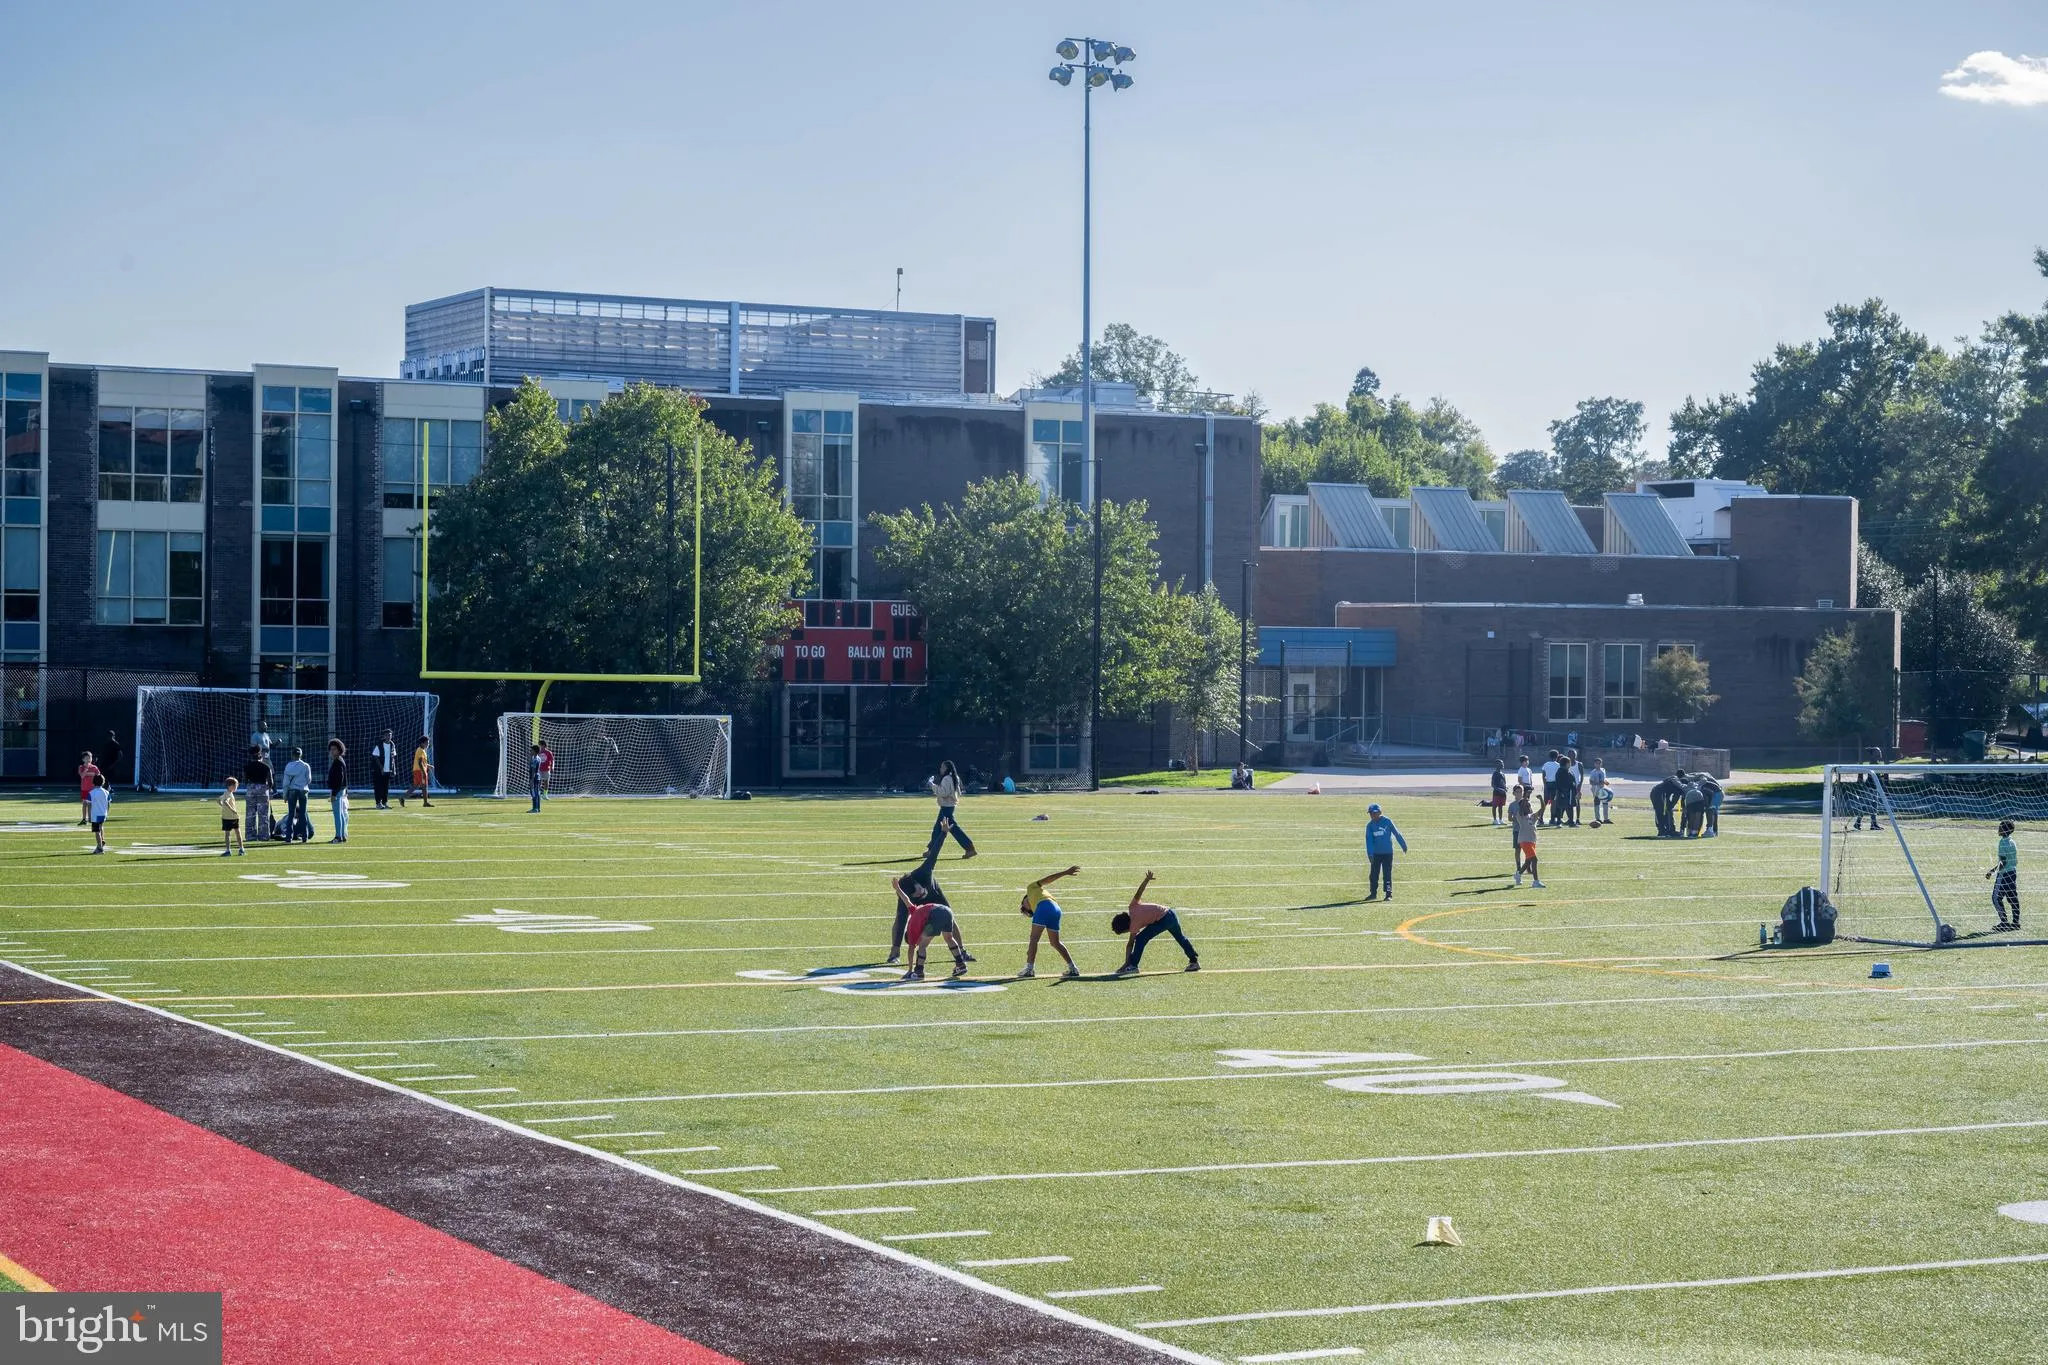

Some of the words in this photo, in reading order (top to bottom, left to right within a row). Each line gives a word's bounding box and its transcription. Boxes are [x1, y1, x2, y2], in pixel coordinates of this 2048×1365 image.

[890, 604, 918, 617] GUES
[795, 645, 808, 658] TO
[811, 645, 826, 658] GO
[848, 646, 871, 658] BALL
[872, 646, 885, 658] ON
[892, 646, 913, 659] QTR
[1213, 1048, 1569, 1095] 40
